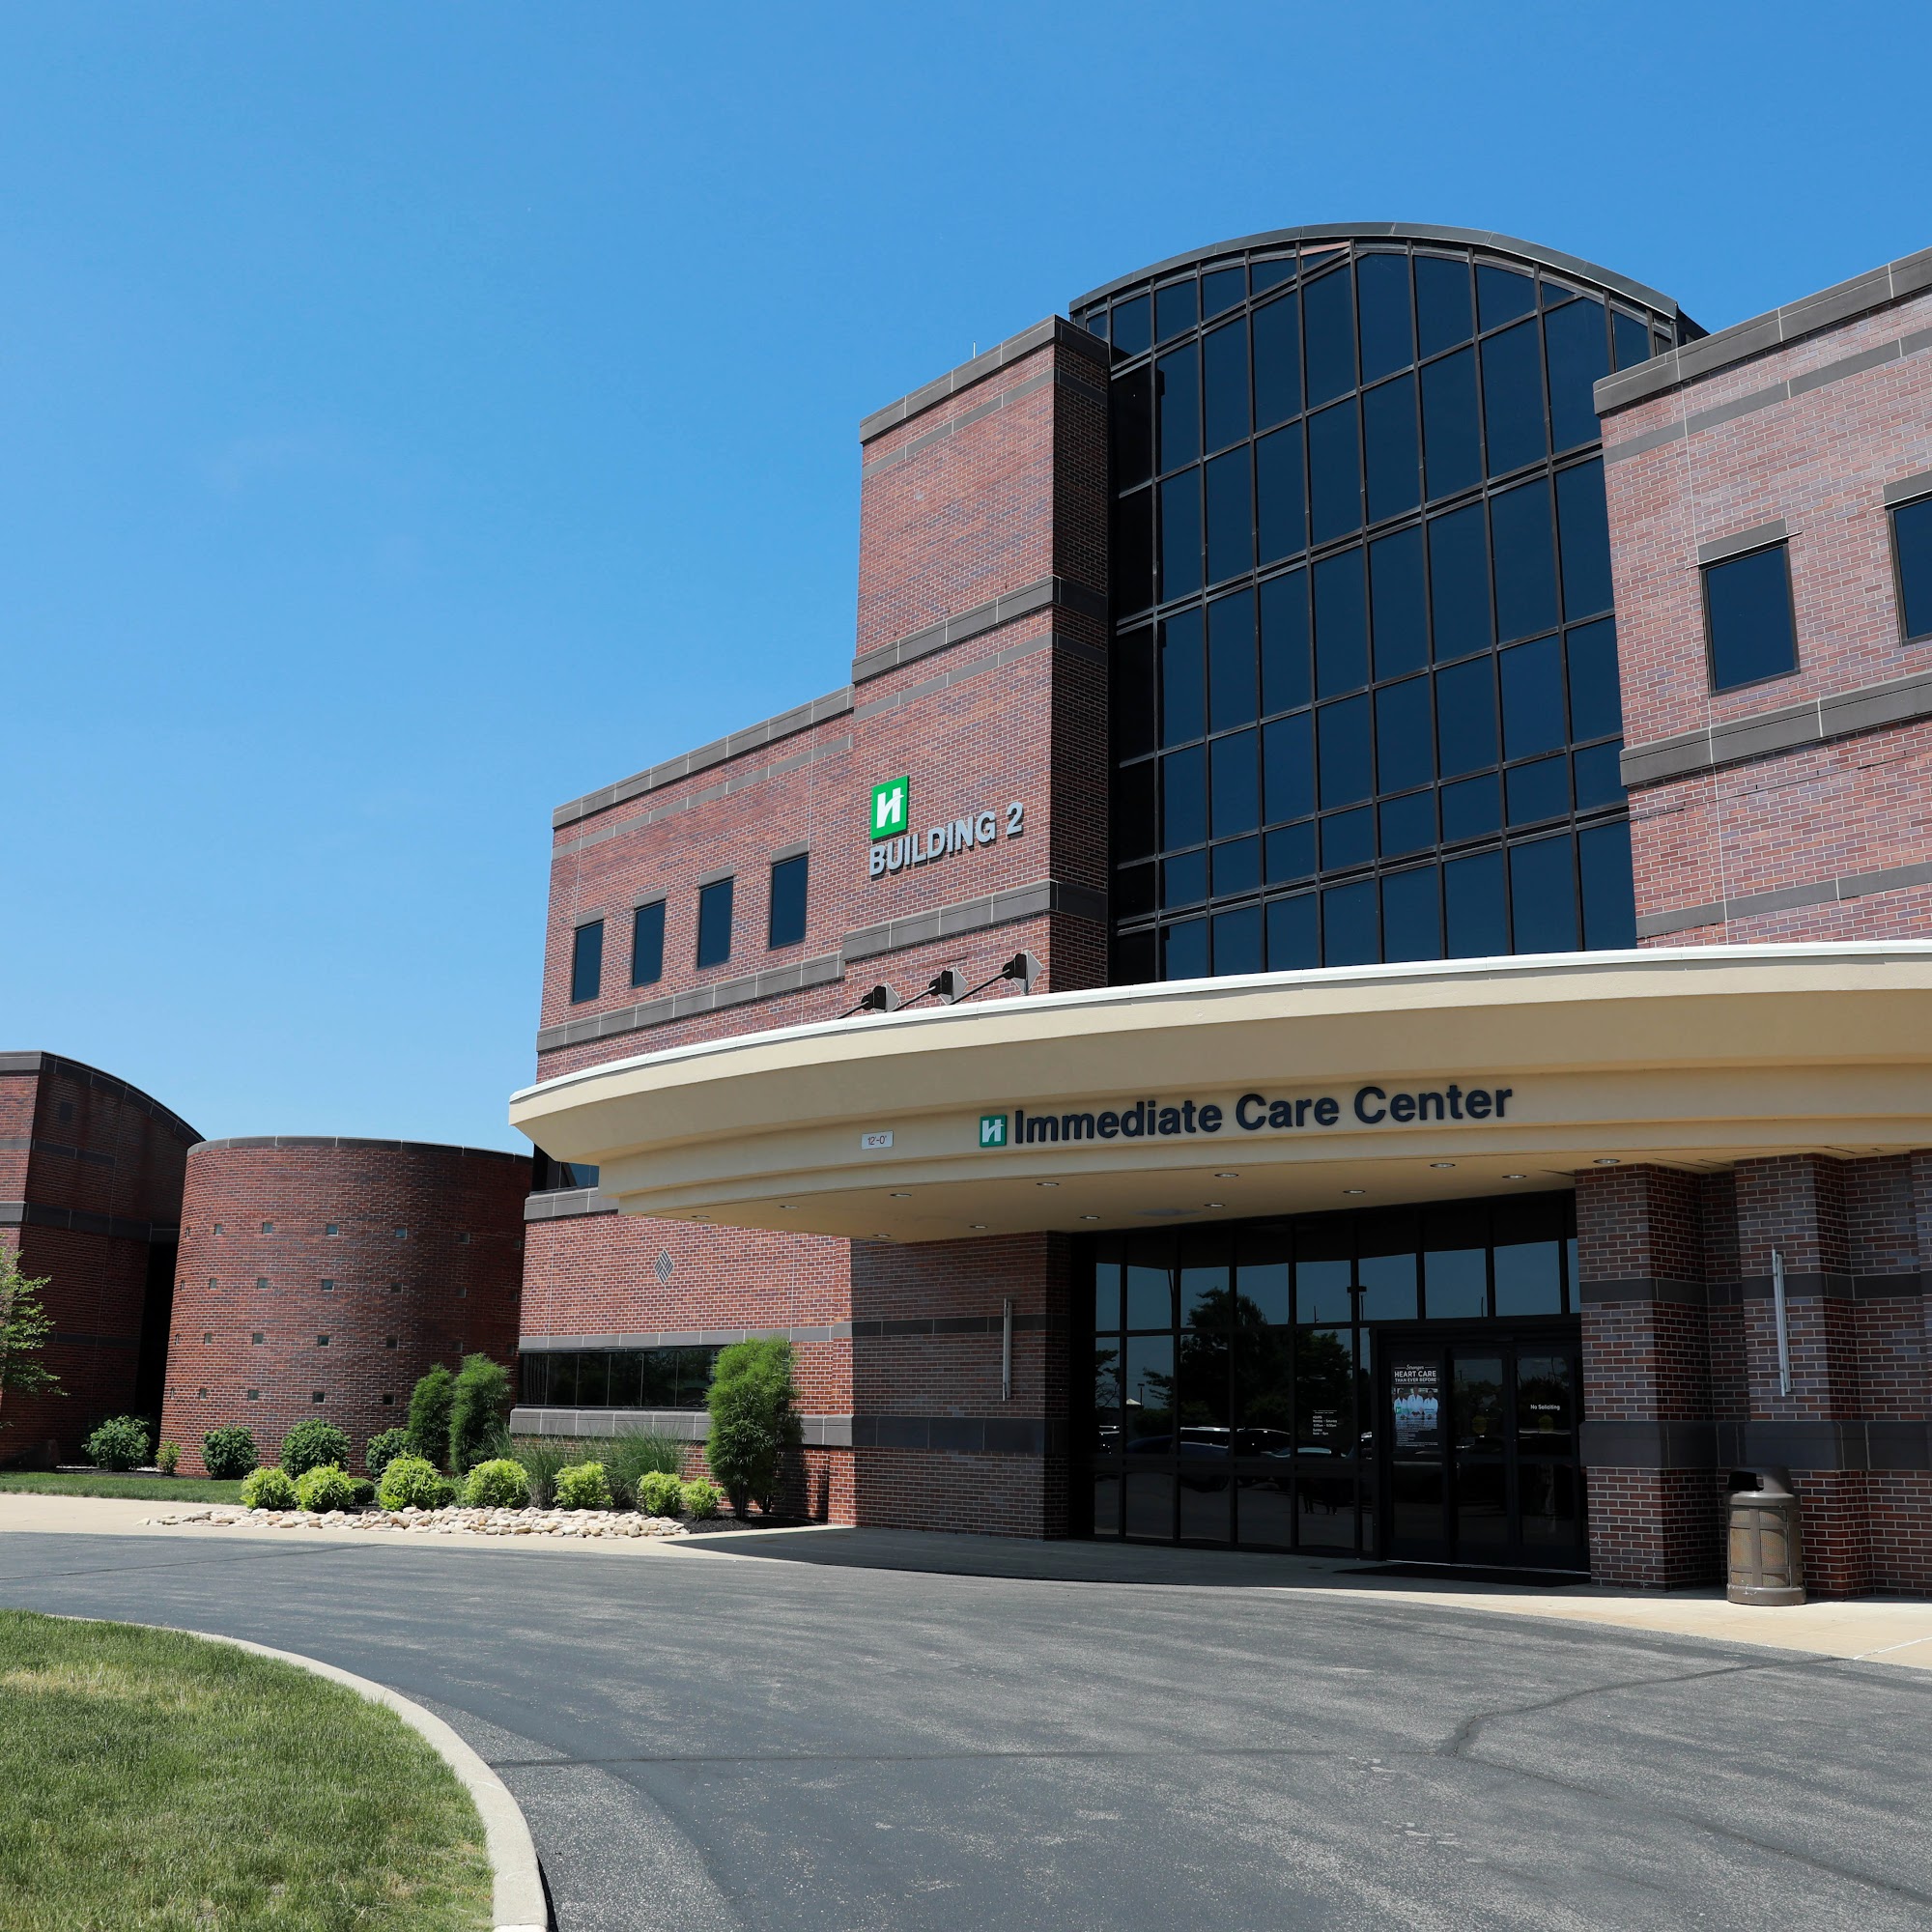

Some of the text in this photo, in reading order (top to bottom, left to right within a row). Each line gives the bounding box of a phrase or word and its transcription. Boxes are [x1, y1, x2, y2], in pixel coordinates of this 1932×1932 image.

[869, 801, 1024, 876] BUILDING 2
[1015, 1100, 1223, 1144] Immediate
[1236, 1094, 1340, 1130] Care
[1353, 1085, 1513, 1123] Center
